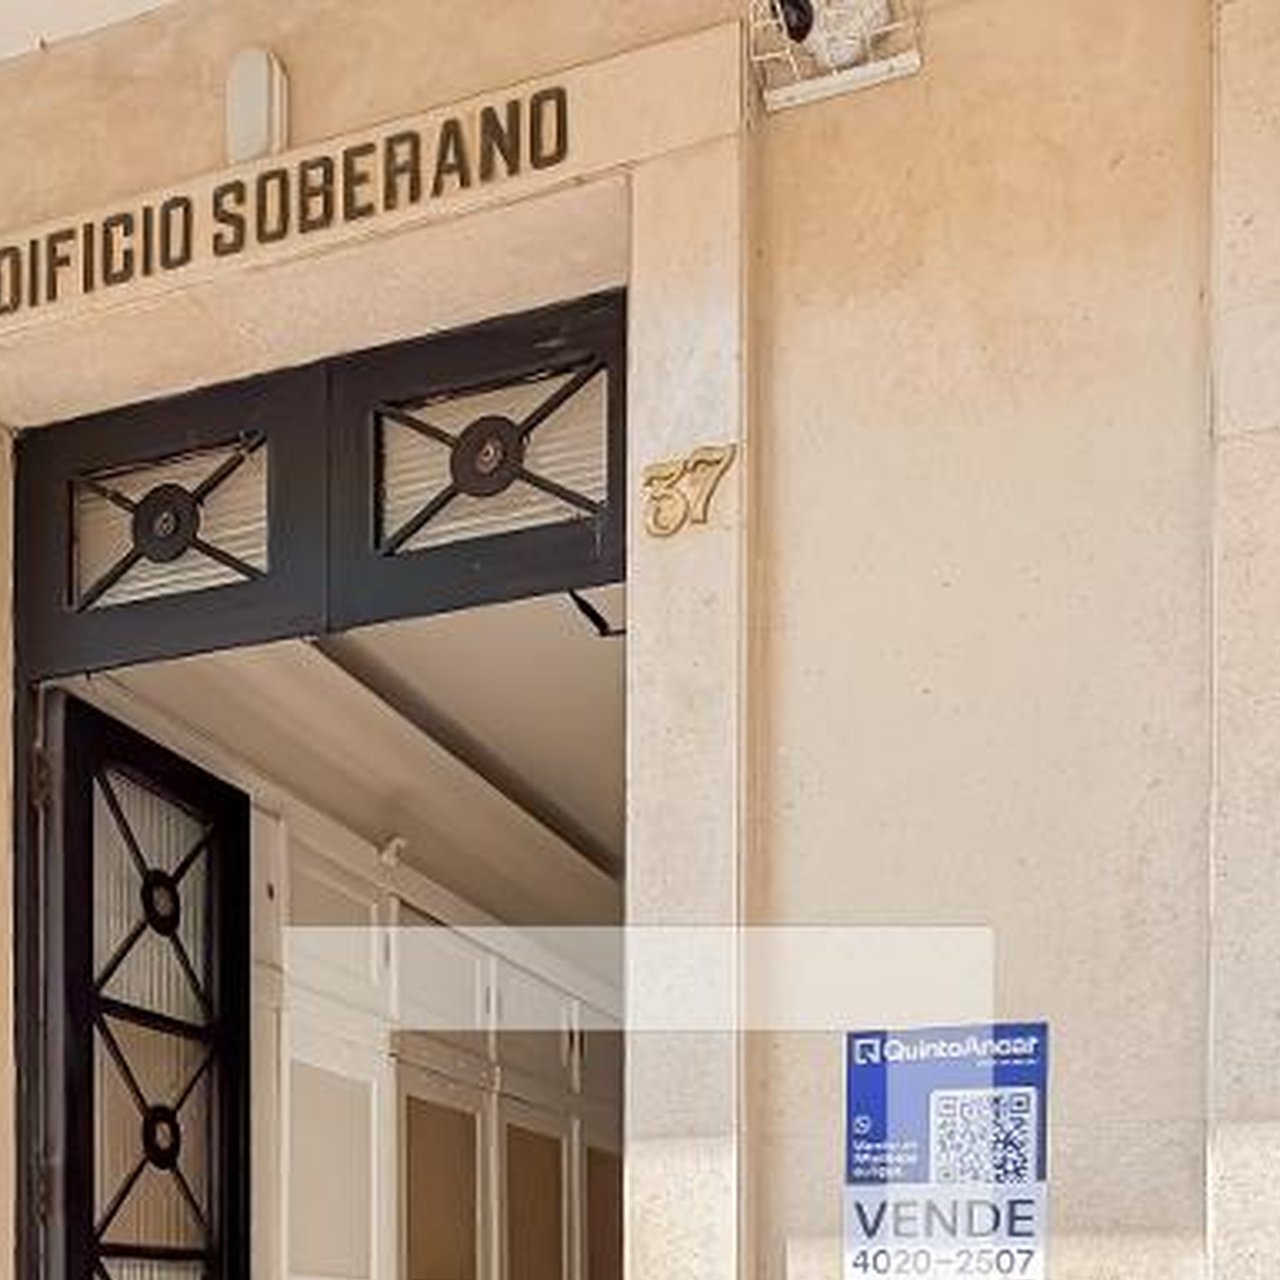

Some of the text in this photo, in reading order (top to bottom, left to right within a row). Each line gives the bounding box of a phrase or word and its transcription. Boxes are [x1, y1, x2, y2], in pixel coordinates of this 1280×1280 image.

[211, 84, 570, 258] SOBERANO
[643, 441, 738, 539] 37
[854, 1199, 1036, 1239] VENDE
[852, 1248, 1036, 1275] 4020-2507
